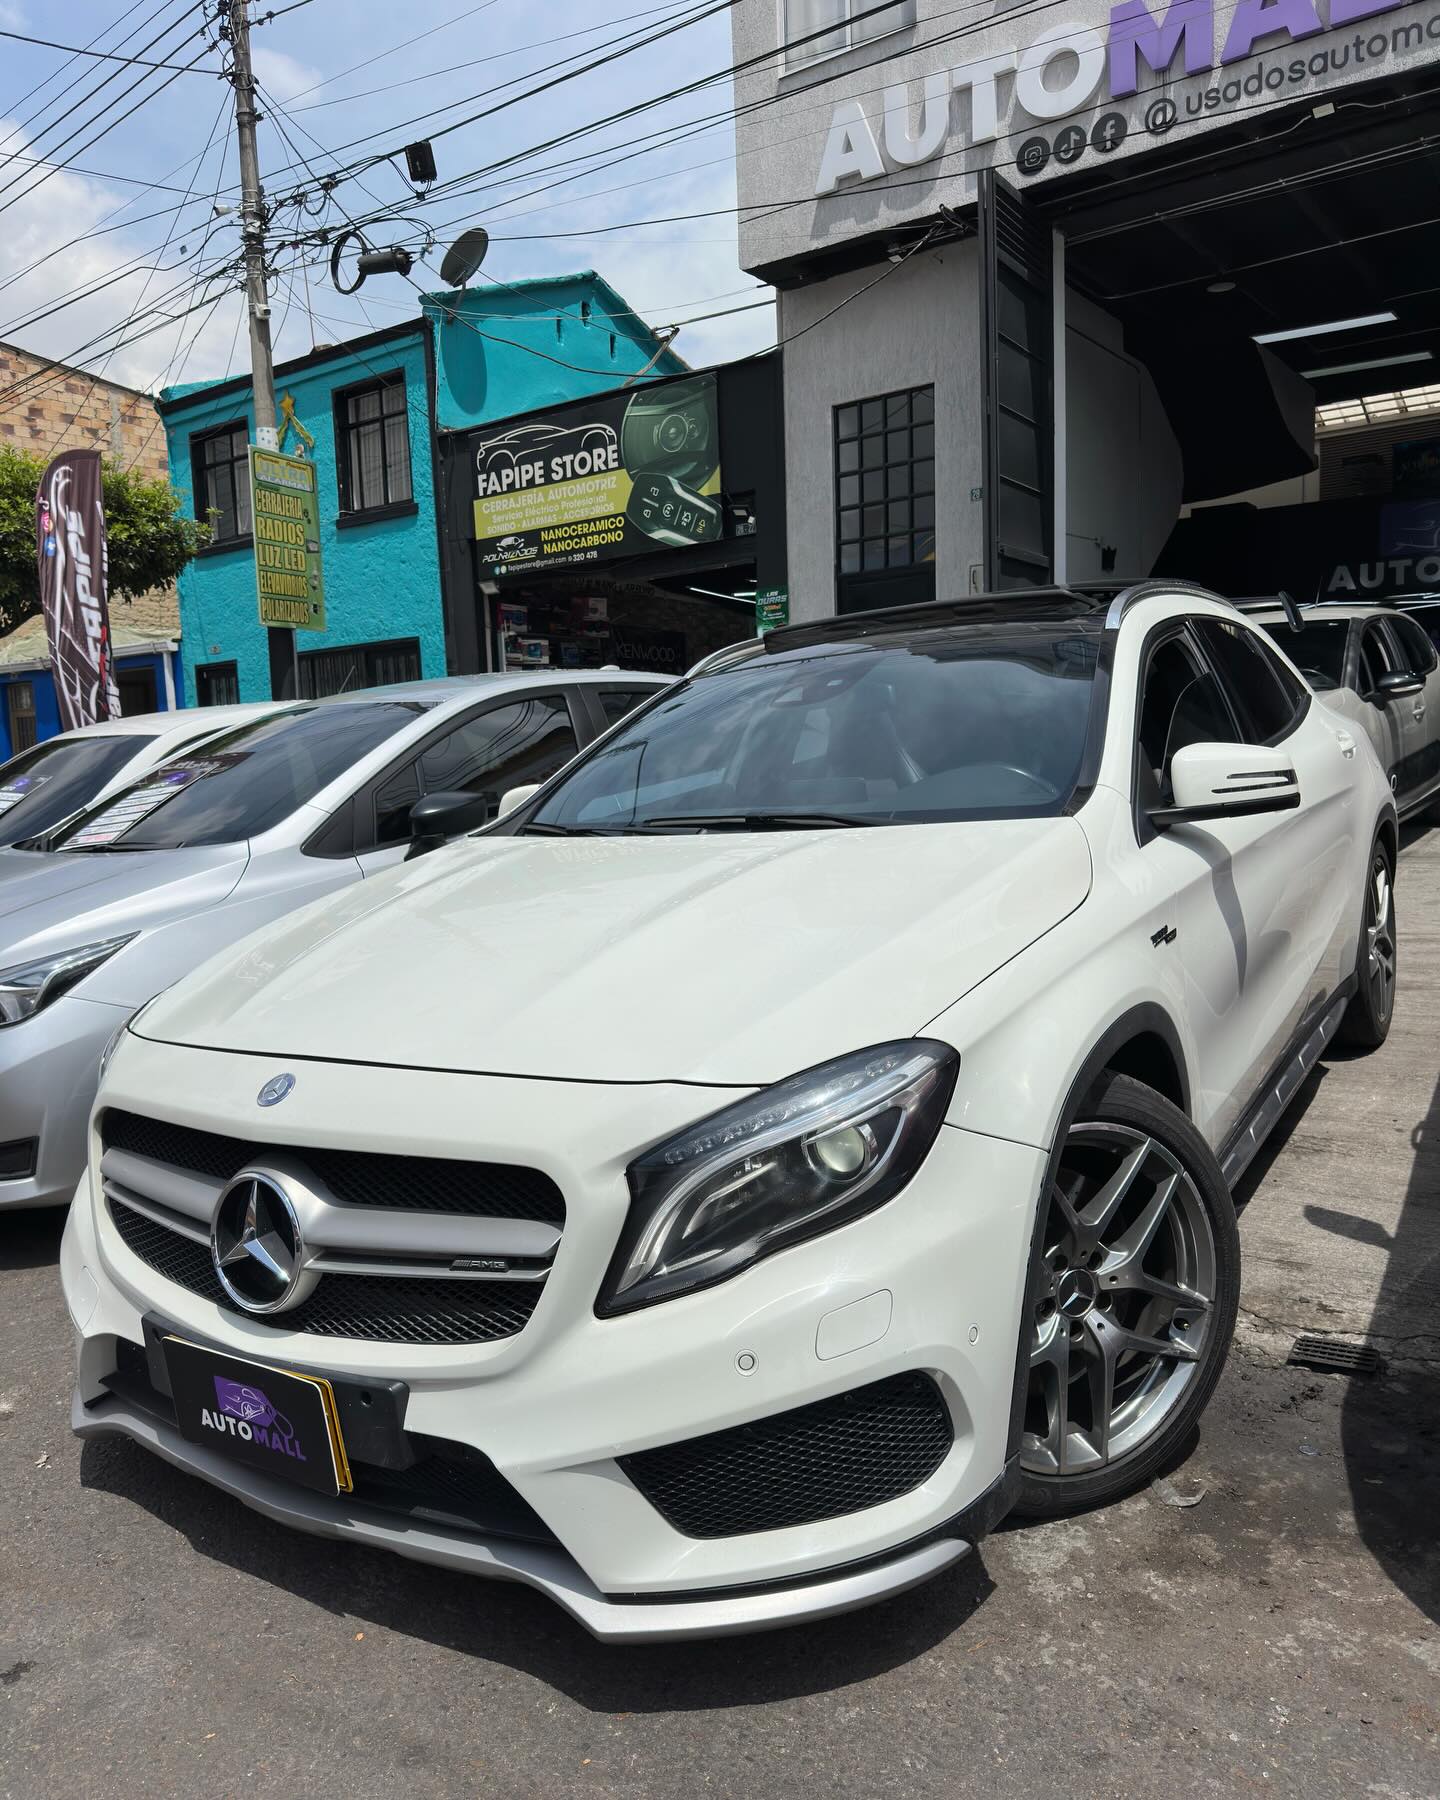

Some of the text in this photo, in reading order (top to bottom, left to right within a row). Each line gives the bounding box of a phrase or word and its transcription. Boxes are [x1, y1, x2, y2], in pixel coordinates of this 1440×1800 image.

[815, 0, 1402, 196] AUTOMA
[477, 444, 619, 497] FAPIPE STORE
[547, 476, 617, 501] AUTOMOTRIZ
[255, 488, 304, 520] CERRAJERIA
[492, 509, 523, 524] Servicio
[256, 516, 305, 546] RADIOS
[487, 502, 615, 535] SONIDO ALARMAS ACCESORIOS
[541, 516, 625, 541] NANOCERAMICO
[482, 546, 539, 563] POLARIZADOS
[543, 530, 624, 555] NANOCARBONO
[258, 543, 306, 572] LUZ LED
[508, 556, 567, 572] fapipestore@gmail.com
[573, 552, 585, 562] 320
[260, 570, 308, 598] ELEVAVIDRIOS
[1327, 556, 1440, 592] AUTO
[261, 597, 309, 624] POLARIZADOS
[471, 1260, 505, 1268] AMG
[201, 1408, 307, 1461] AUTOMALL
